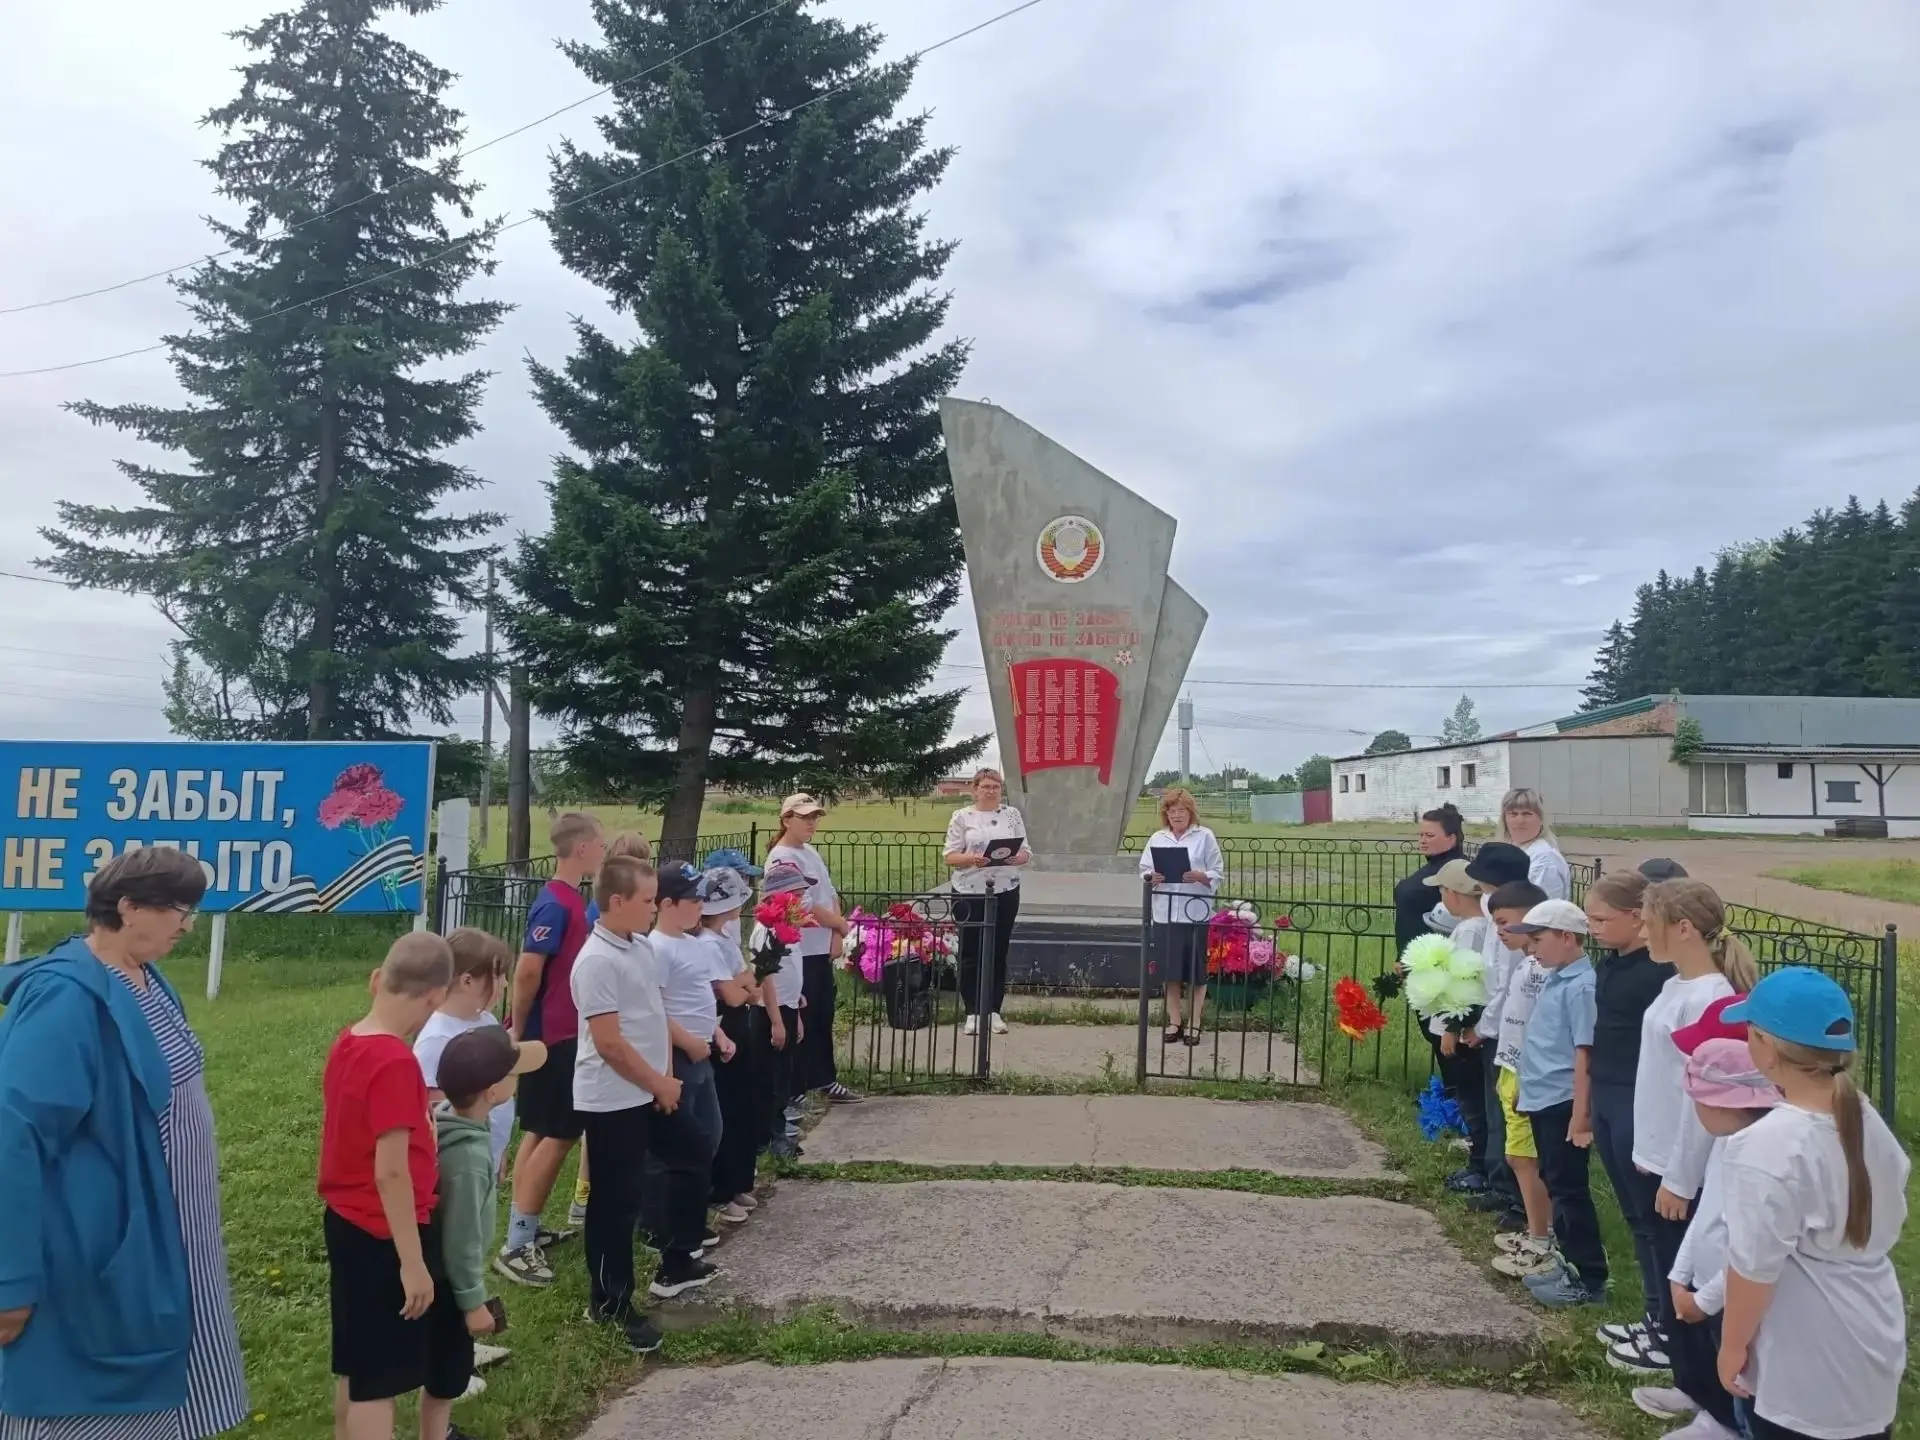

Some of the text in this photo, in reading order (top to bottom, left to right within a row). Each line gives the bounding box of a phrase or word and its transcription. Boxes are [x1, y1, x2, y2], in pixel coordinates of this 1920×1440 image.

[16, 767, 296, 829] НЕ ЗАБЫТ,
[2, 836, 293, 893] НЕ ЗЫТО
